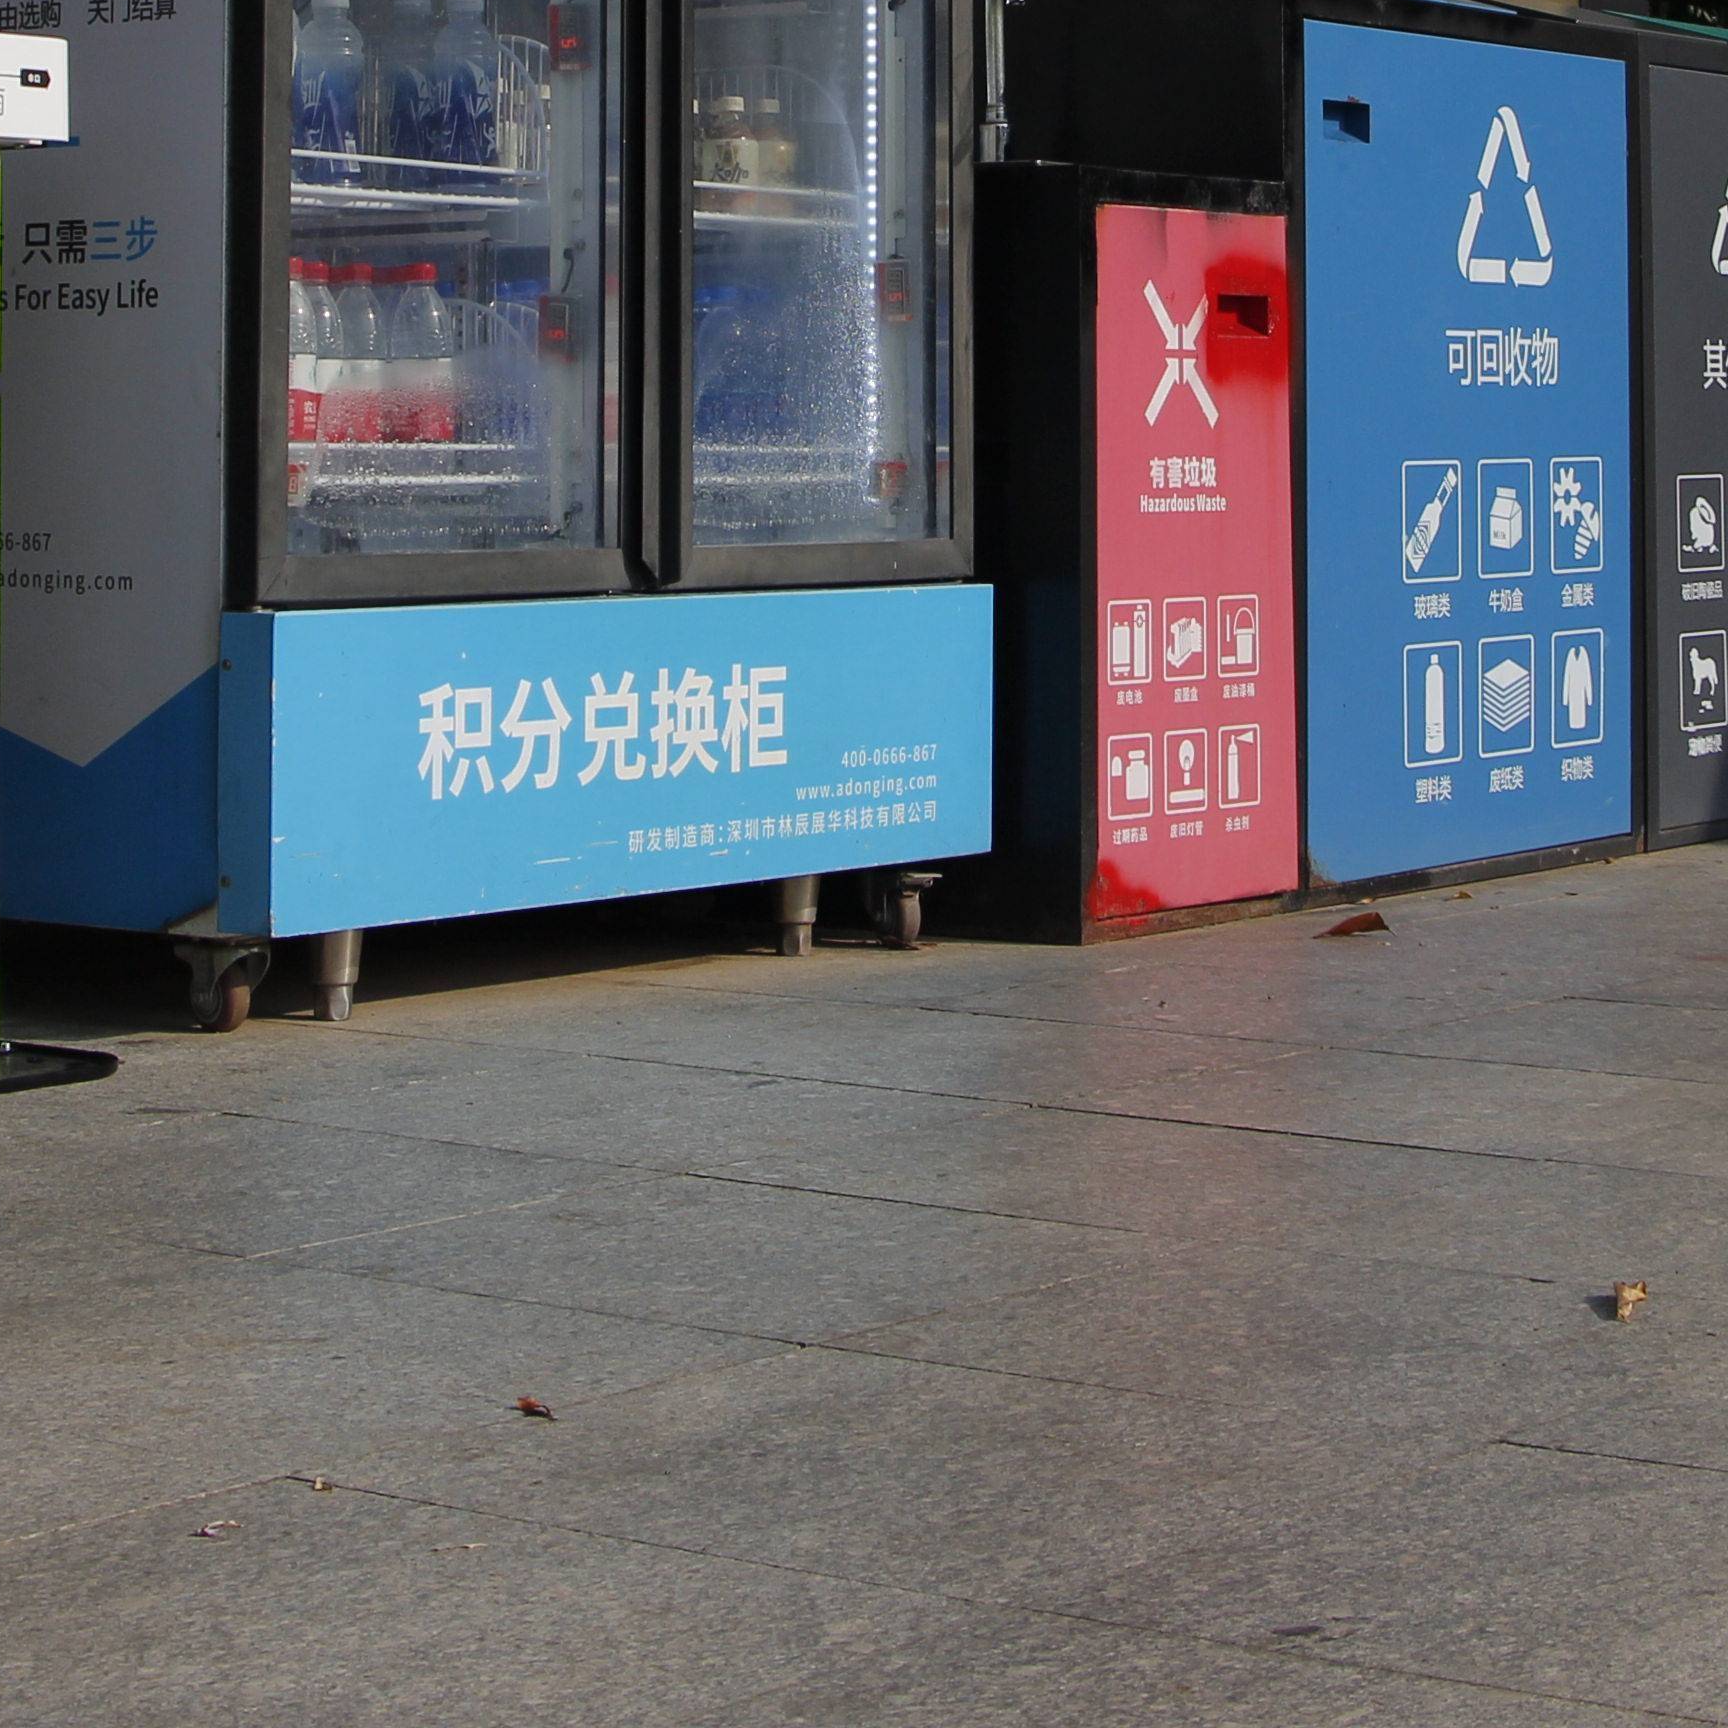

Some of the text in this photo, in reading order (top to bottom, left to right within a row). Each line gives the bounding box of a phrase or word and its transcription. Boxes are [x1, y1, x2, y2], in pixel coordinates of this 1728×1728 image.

[22, 215, 158, 266] 只需三步
[15, 284, 52, 312] For
[58, 282, 111, 317] Easy
[116, 278, 159, 309] Life
[1444, 327, 1560, 388] 可回收物
[1149, 456, 1217, 490] 有害垃圾
[1140, 493, 1228, 513] Hazardous Waste
[1413, 581, 1595, 620] 玻璃类 牛奶盒 金属类
[418, 663, 789, 801] 积分兑换柜
[840, 743, 939, 771] 400-0666-867
[795, 772, 939, 802] www.adonging.com
[1414, 755, 1595, 805] 塑料类 废纸类 织物类
